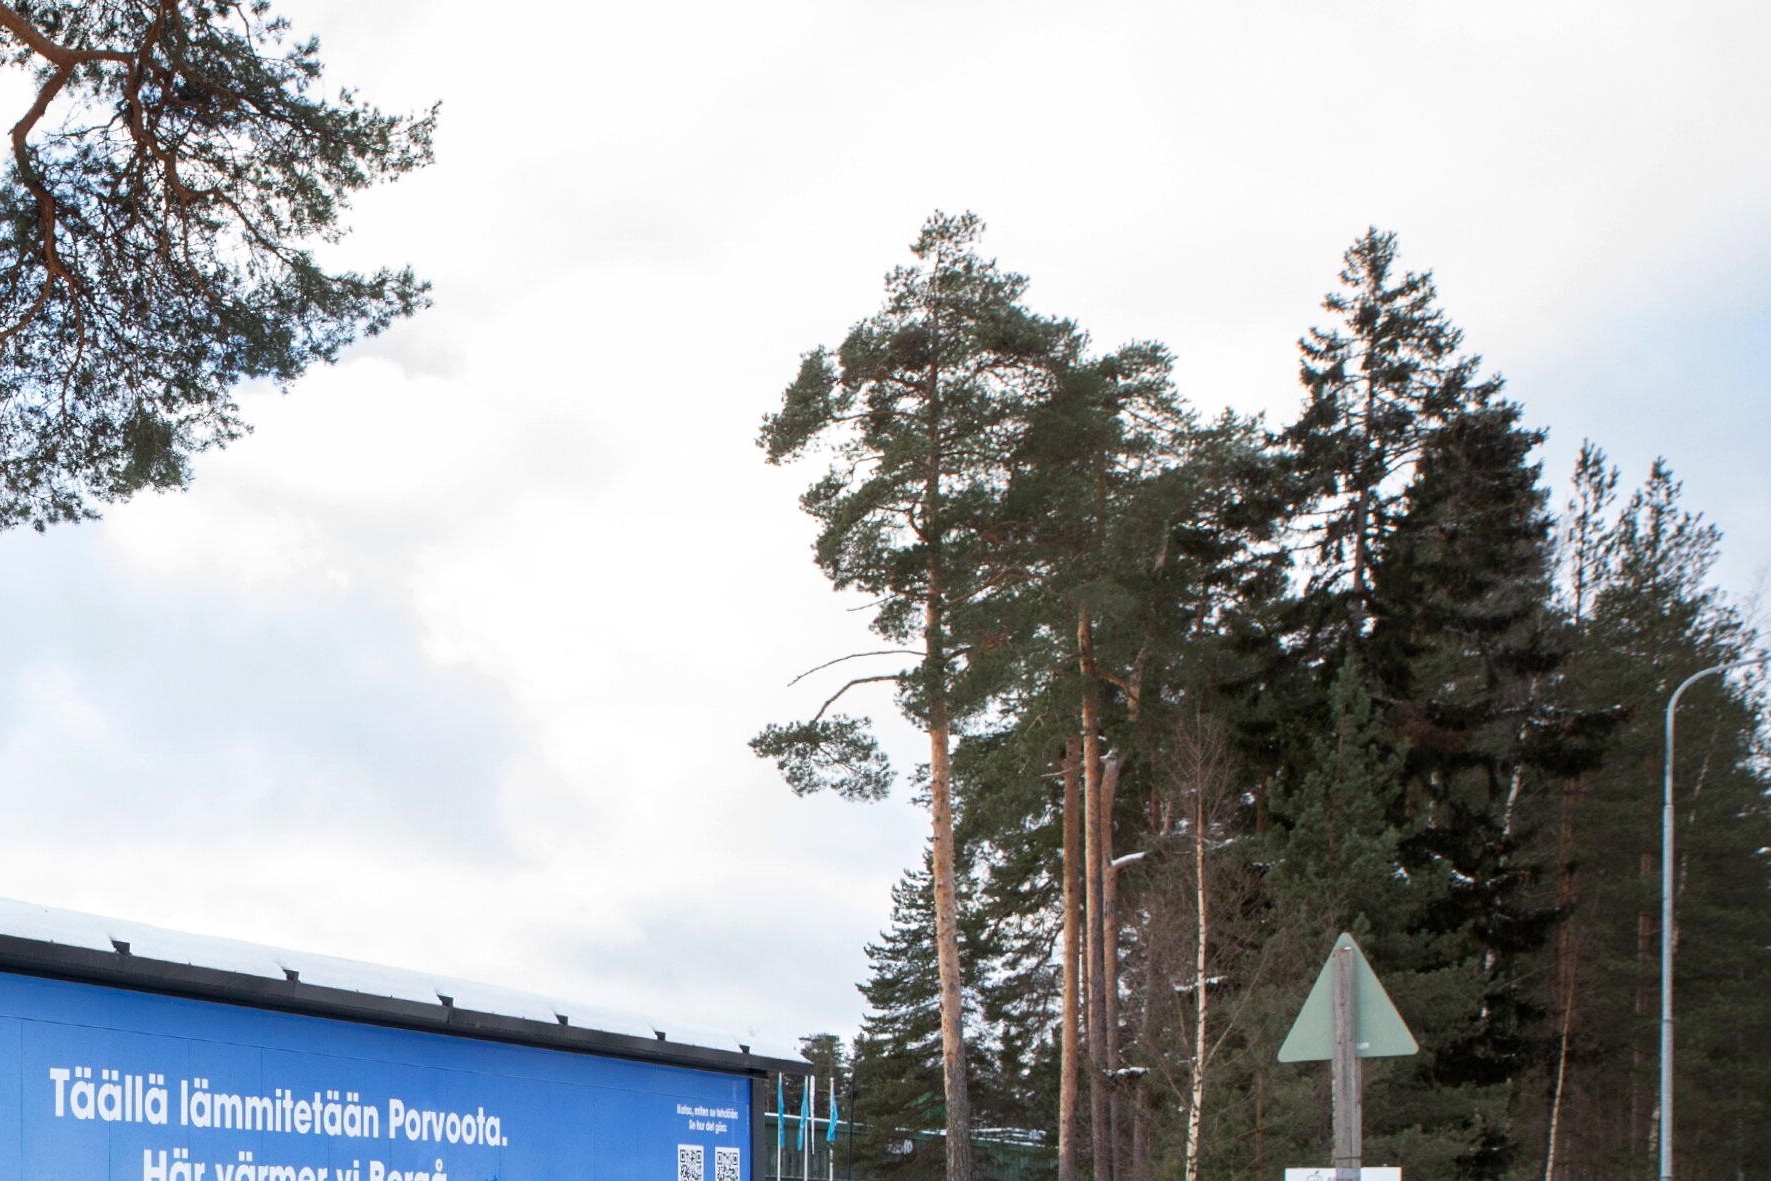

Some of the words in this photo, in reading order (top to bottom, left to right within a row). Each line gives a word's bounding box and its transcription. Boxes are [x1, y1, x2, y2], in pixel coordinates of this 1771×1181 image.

[49, 1066, 168, 1125] Täällä
[180, 1077, 379, 1138] lämmitetään
[389, 1099, 508, 1147] Porvoota.
